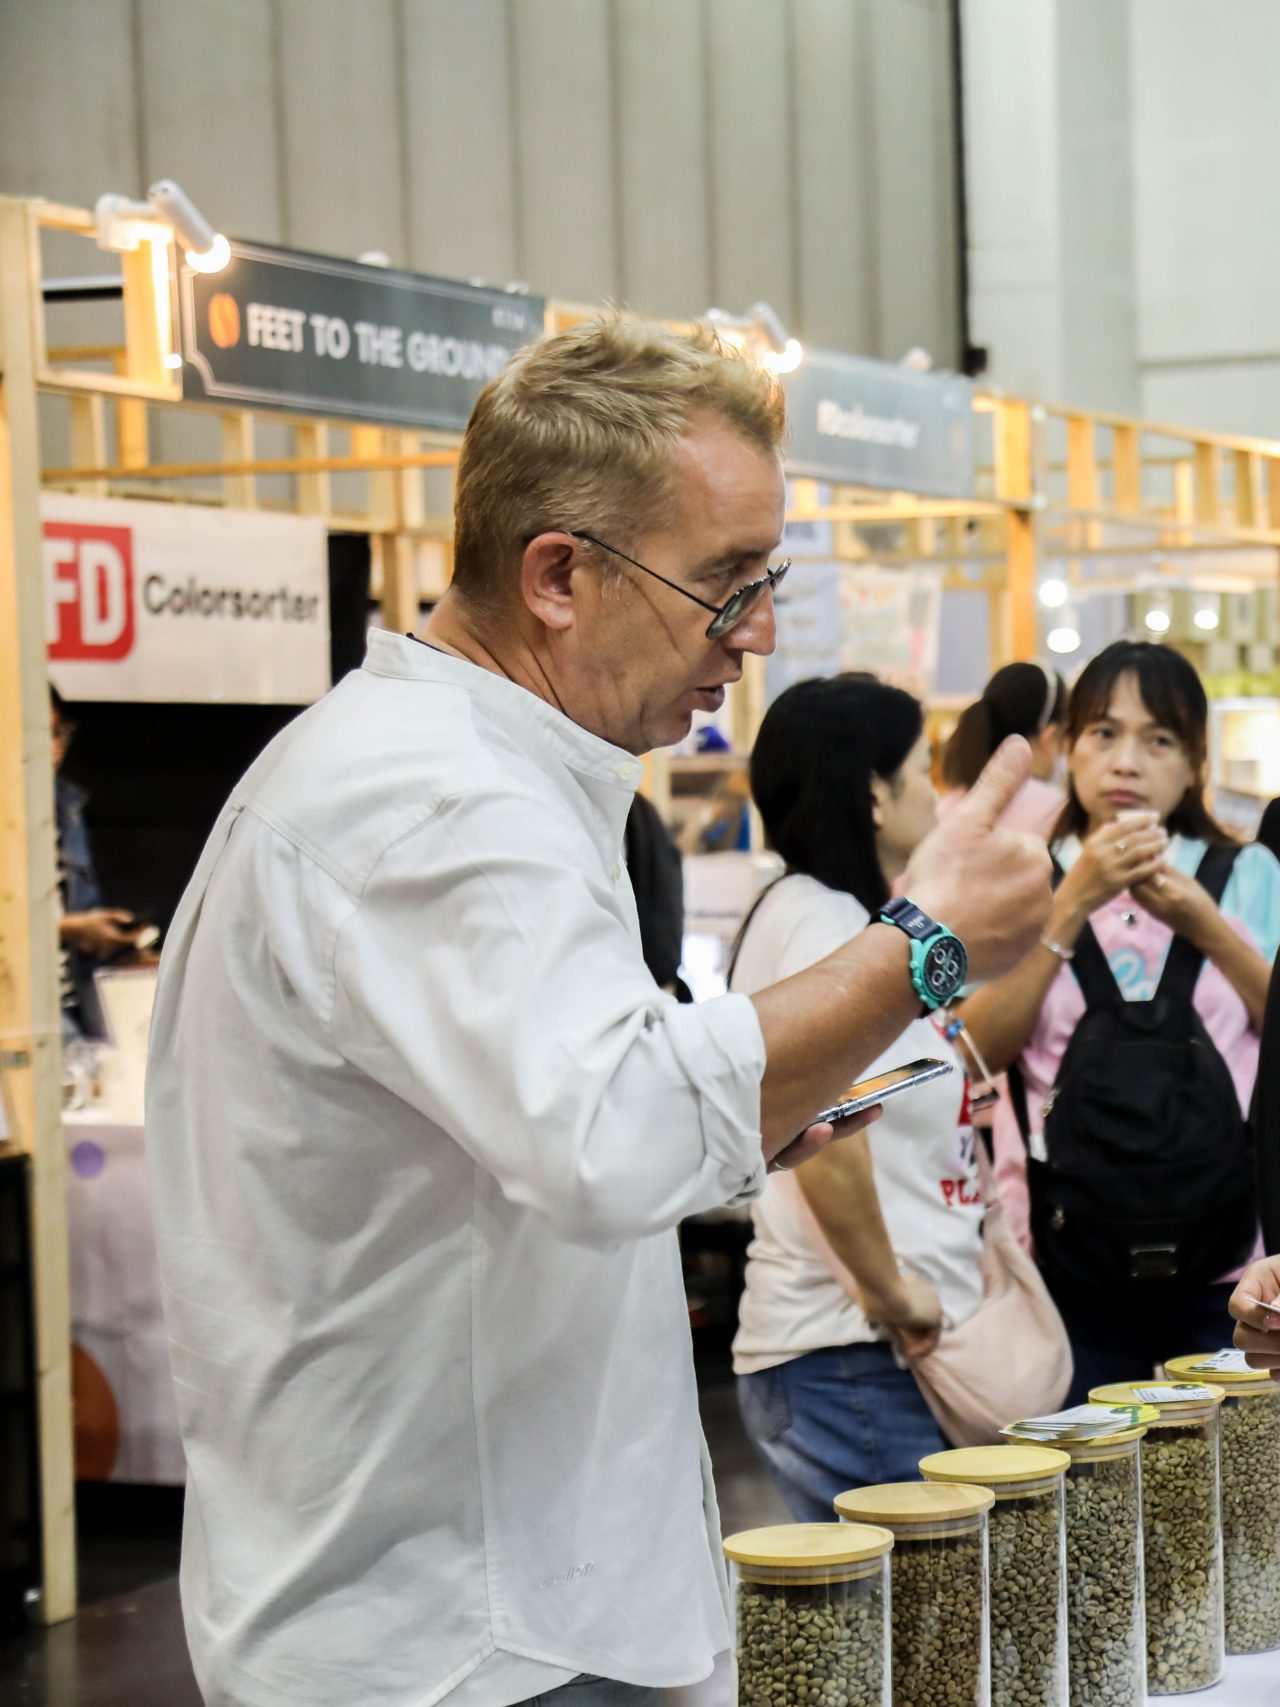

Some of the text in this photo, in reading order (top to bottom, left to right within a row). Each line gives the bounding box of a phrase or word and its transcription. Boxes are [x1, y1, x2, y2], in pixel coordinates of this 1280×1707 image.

[246, 302, 510, 380] FEET TO THE GROUN
[143, 573, 319, 622] Colorsorter
